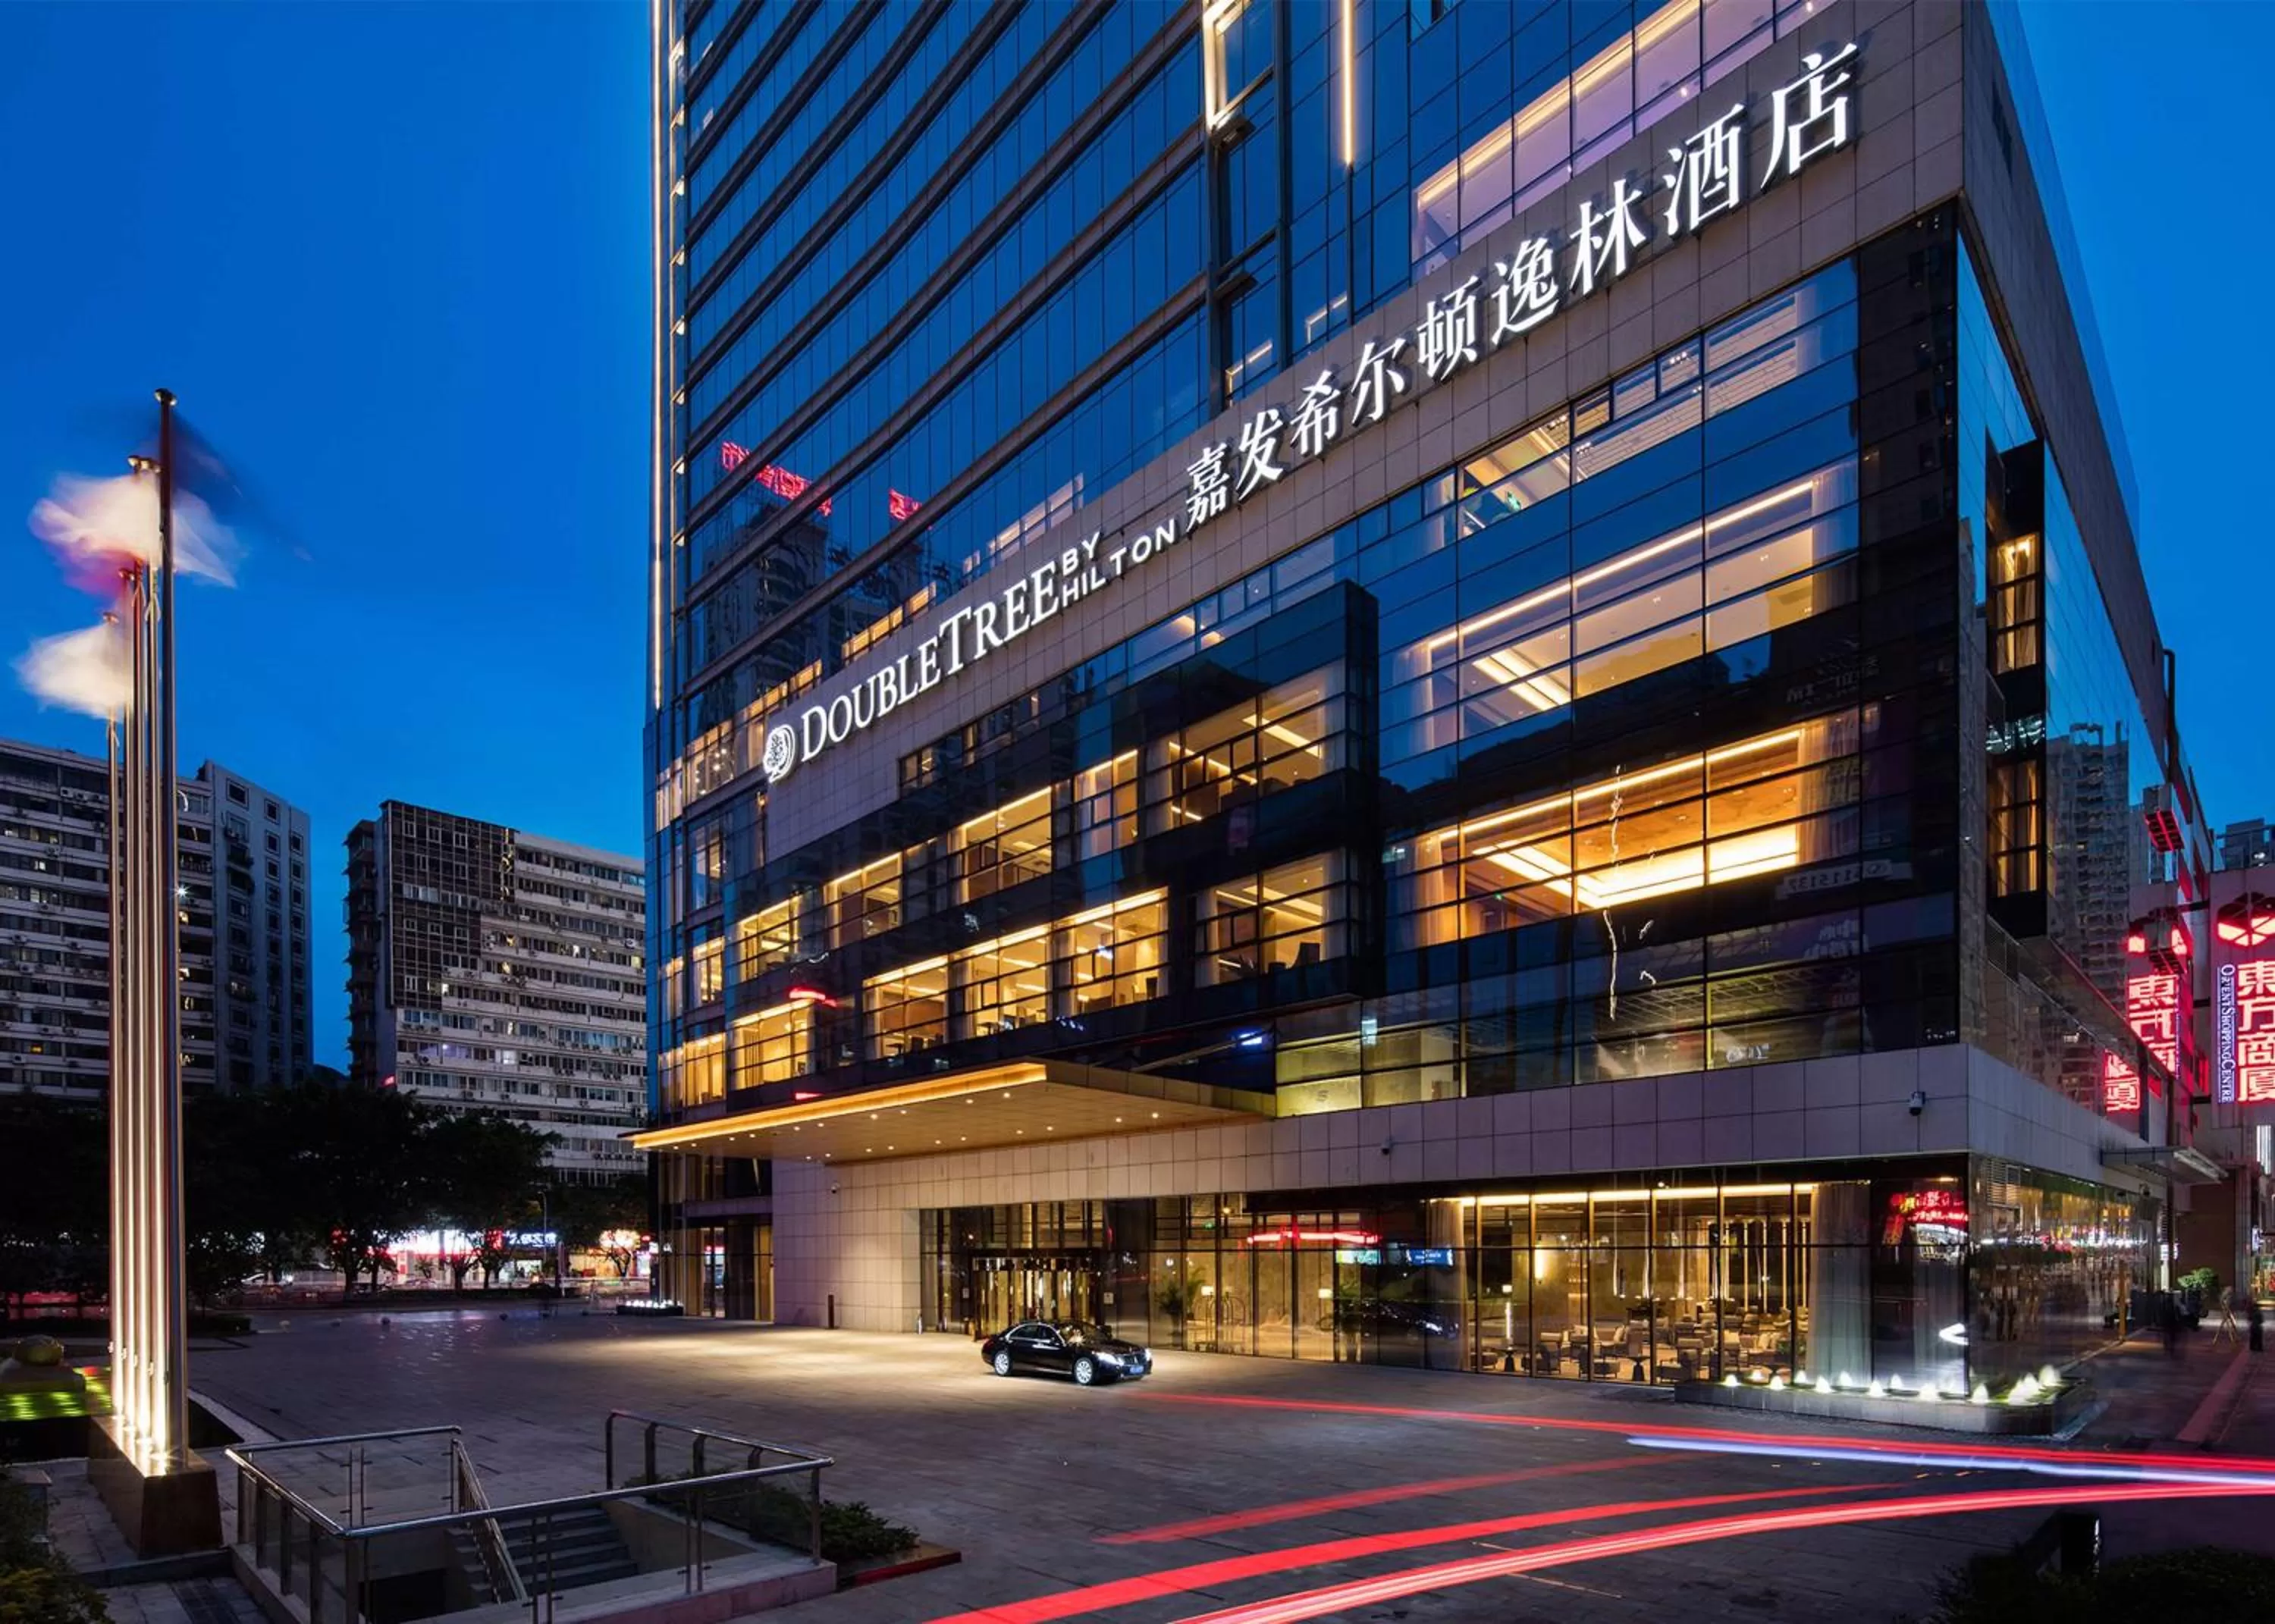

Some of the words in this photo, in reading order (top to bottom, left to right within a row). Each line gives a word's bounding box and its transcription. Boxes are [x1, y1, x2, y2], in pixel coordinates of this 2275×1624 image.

[1185, 43, 1858, 531] 嘉发希尔顿逸林酒店
[1062, 532, 1101, 574] BY
[1062, 520, 1176, 607] HILTON
[802, 562, 1059, 761] DOUBLETREE
